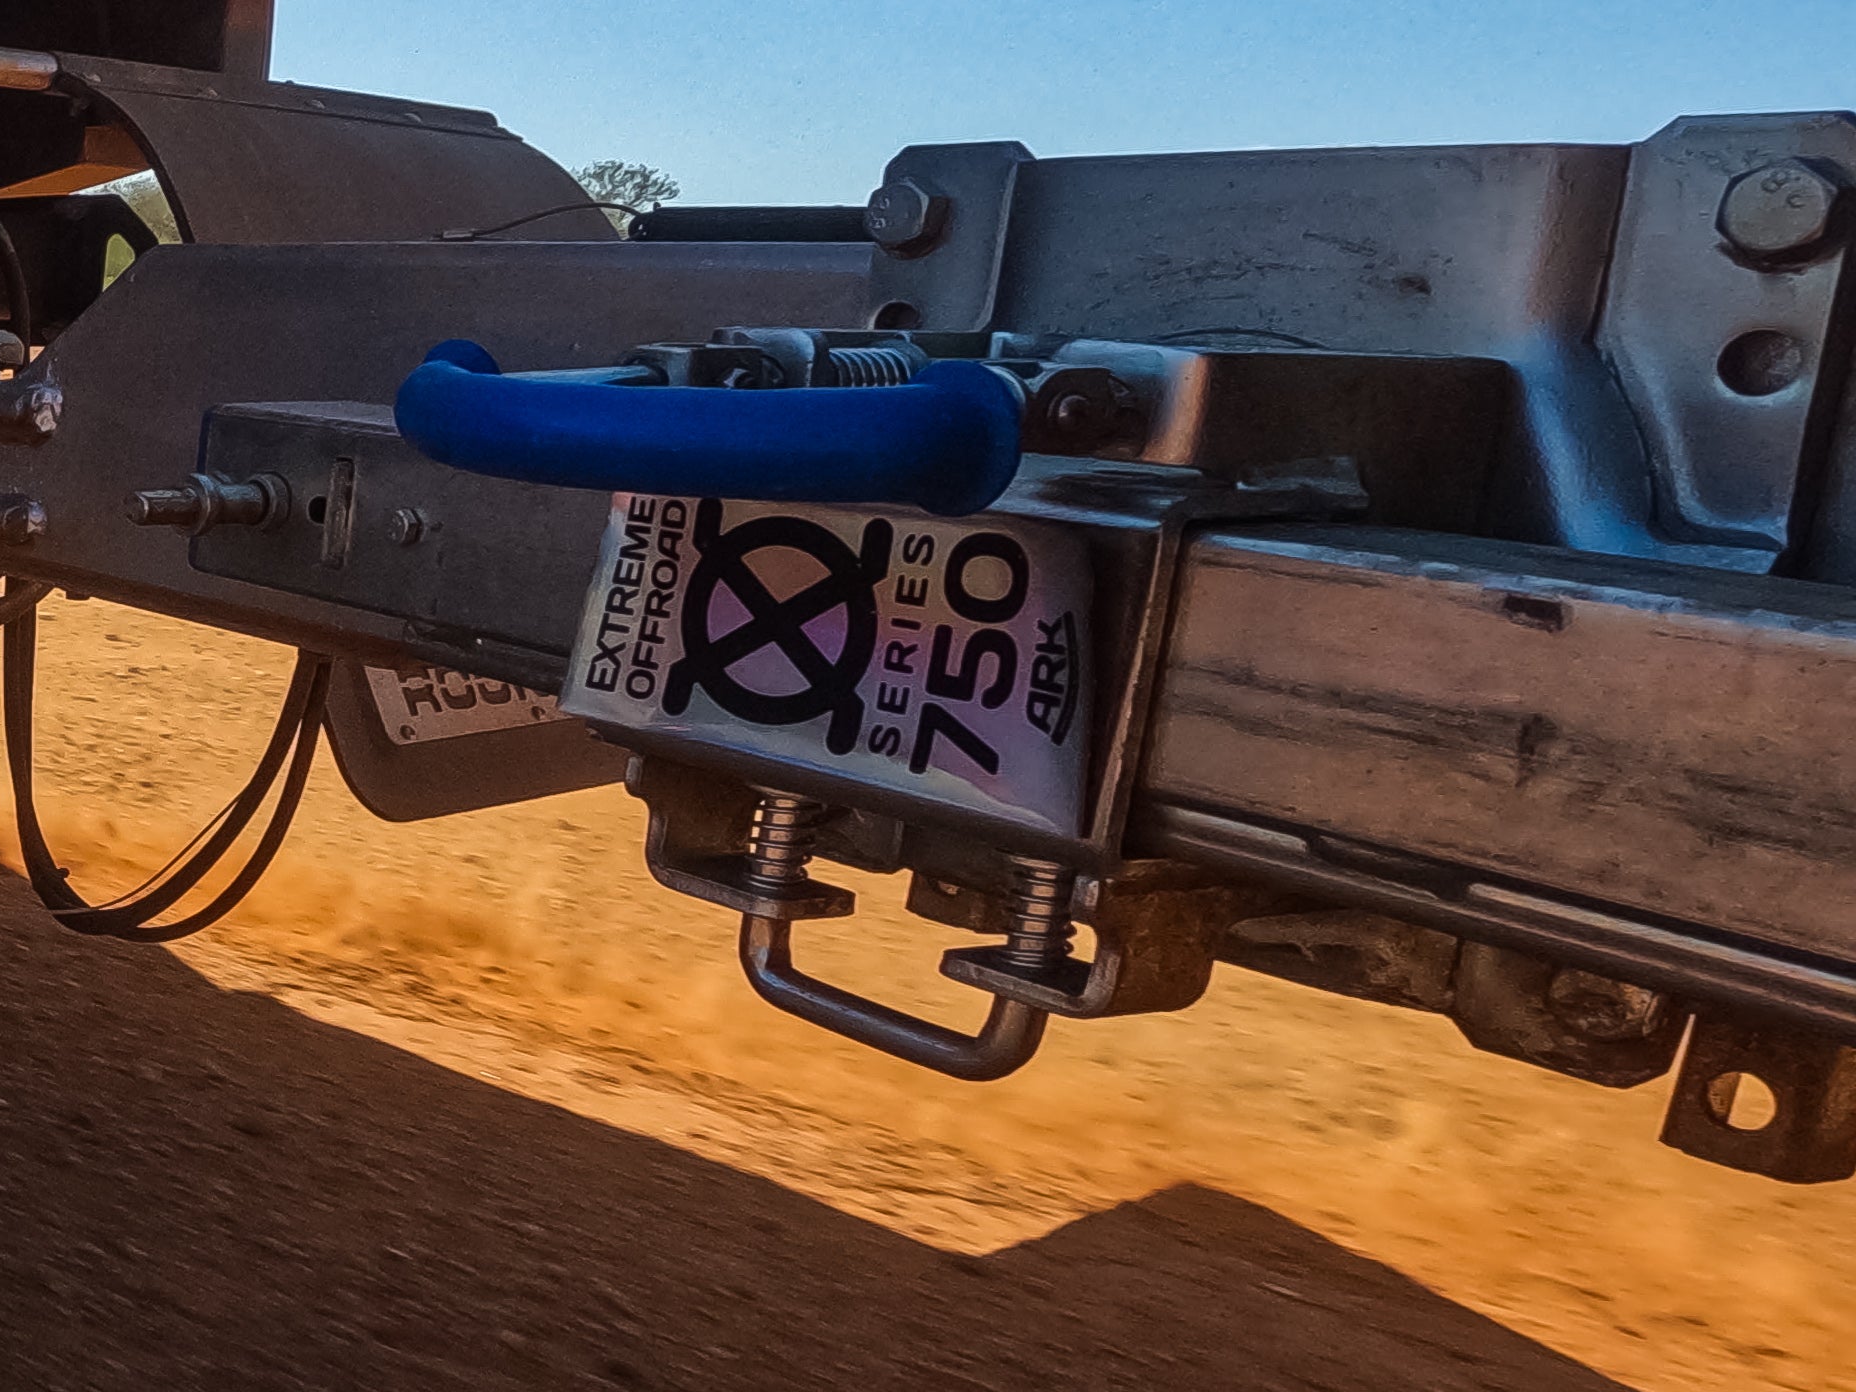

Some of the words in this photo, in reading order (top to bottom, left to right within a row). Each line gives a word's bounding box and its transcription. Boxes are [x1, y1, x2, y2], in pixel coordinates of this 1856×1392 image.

[395, 667, 528, 717] ROC
[585, 495, 658, 694] EXTREME
[624, 498, 688, 701] OFFROAD
[868, 532, 936, 756] SERIES
[910, 533, 1030, 776] 750
[1026, 618, 1072, 734] ARK
